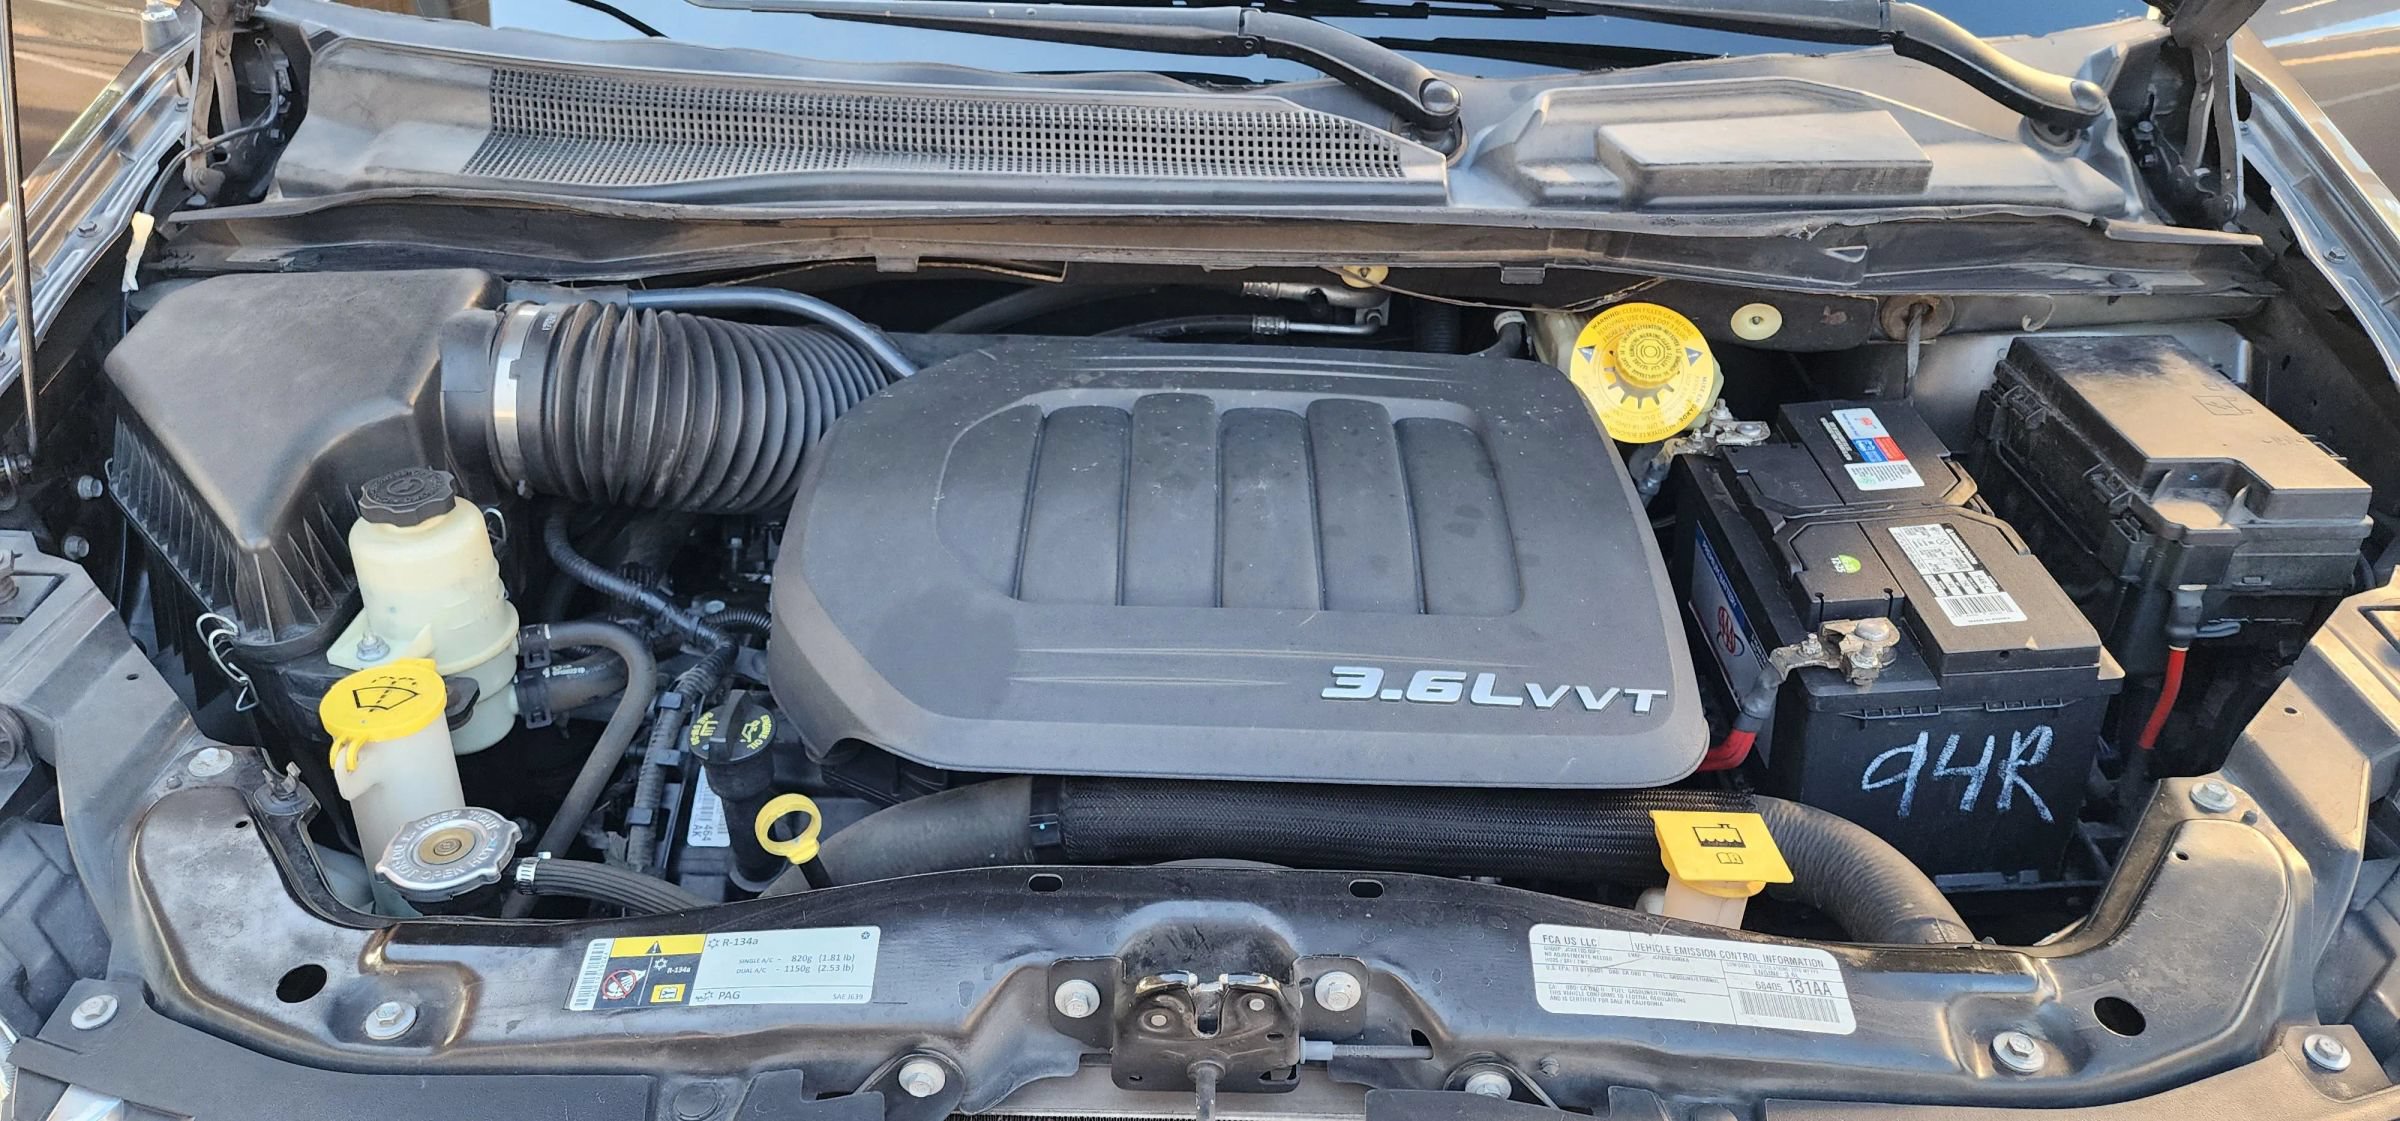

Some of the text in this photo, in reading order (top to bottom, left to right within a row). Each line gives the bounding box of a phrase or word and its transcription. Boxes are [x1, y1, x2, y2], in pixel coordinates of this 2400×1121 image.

[1321, 666, 1668, 715] 3.6L VVT
[746, 714, 772, 750] ENGINE OIL
[415, 810, 500, 830] KEEP TIGHT
[420, 866, 466, 880] OPEN
[722, 937, 759, 947] R-134a
[1542, 934, 1597, 947] FCA US LLC
[791, 955, 812, 963] 820g
[818, 953, 841, 962] (1.81
[843, 953, 855, 962] lb)
[1635, 943, 1824, 968] VEHICLE EMISSION CONTROL INFORMATION
[784, 965, 811, 974] 1150g
[817, 964, 840, 973] (2.53
[842, 963, 855, 973] lb)
[1755, 979, 1833, 996] 68405 131AA
[718, 991, 741, 1000] PAG
